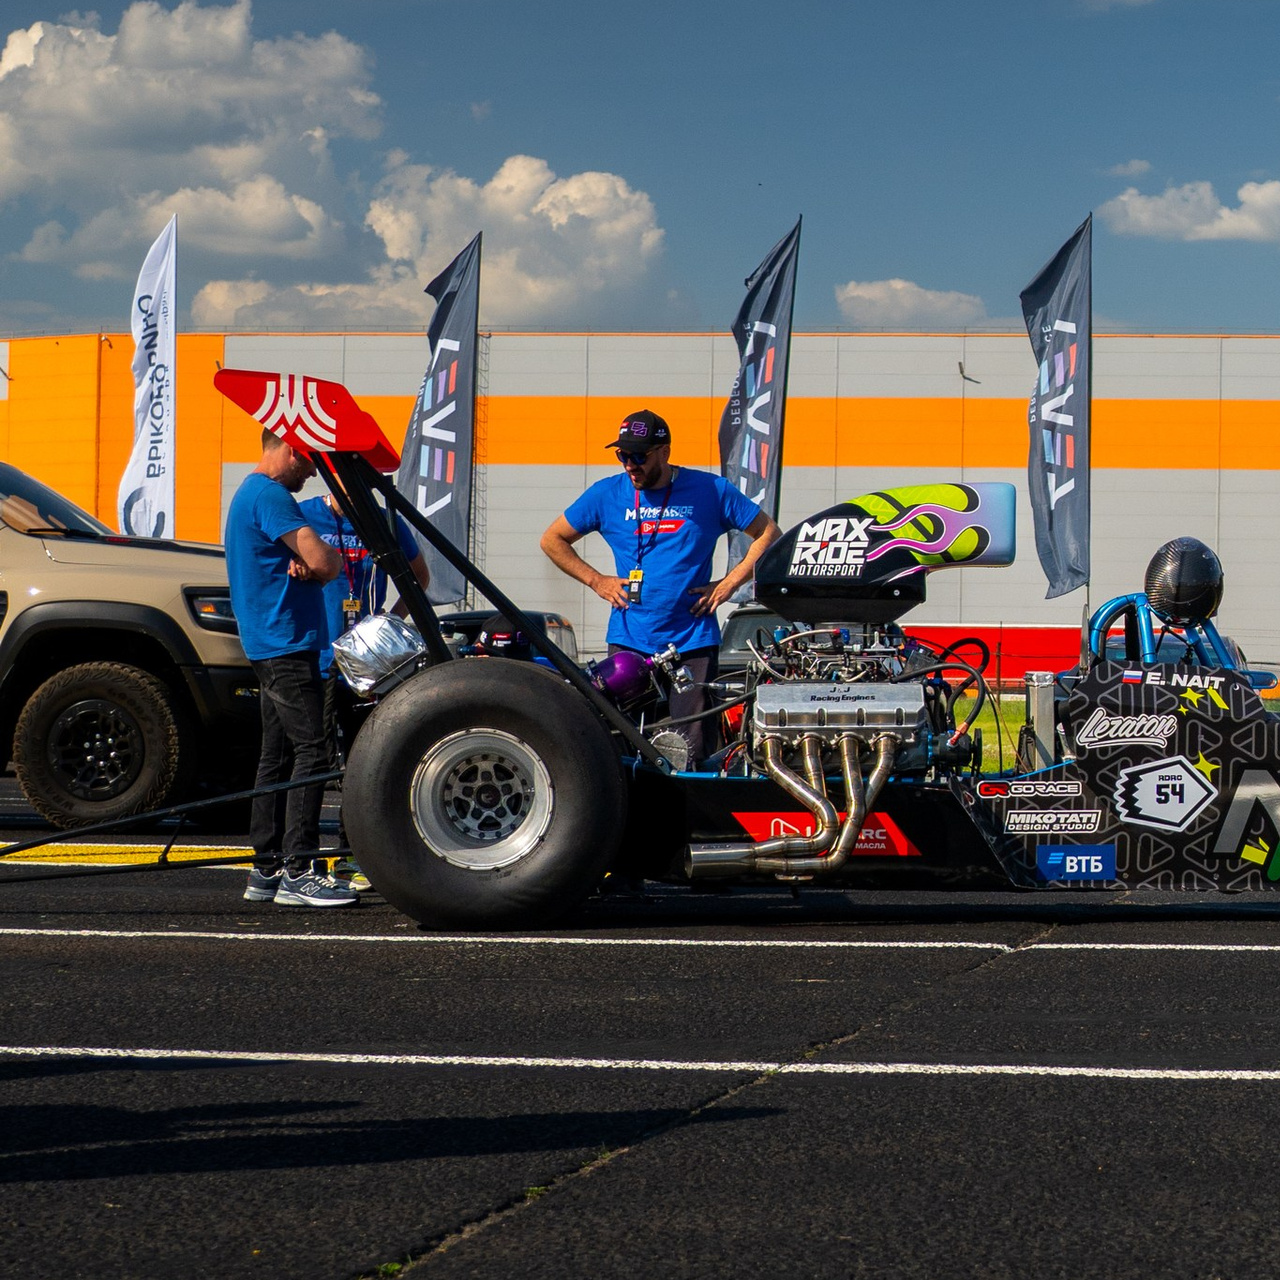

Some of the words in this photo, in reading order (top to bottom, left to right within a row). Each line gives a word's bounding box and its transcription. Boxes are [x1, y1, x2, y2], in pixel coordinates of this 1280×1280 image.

[798, 518, 875, 542] MAX
[788, 564, 863, 576] MOTORSPORT
[1145, 671, 1166, 686] E.
[1171, 673, 1226, 690] NAIT
[841, 694, 876, 702] Engines
[1011, 784, 1079, 793] GORACE
[1156, 783, 1184, 804] 54
[1009, 813, 1098, 824] MIKOTATI
[855, 842, 887, 850] МАСЛА
[1065, 856, 1103, 873] ВТБ
